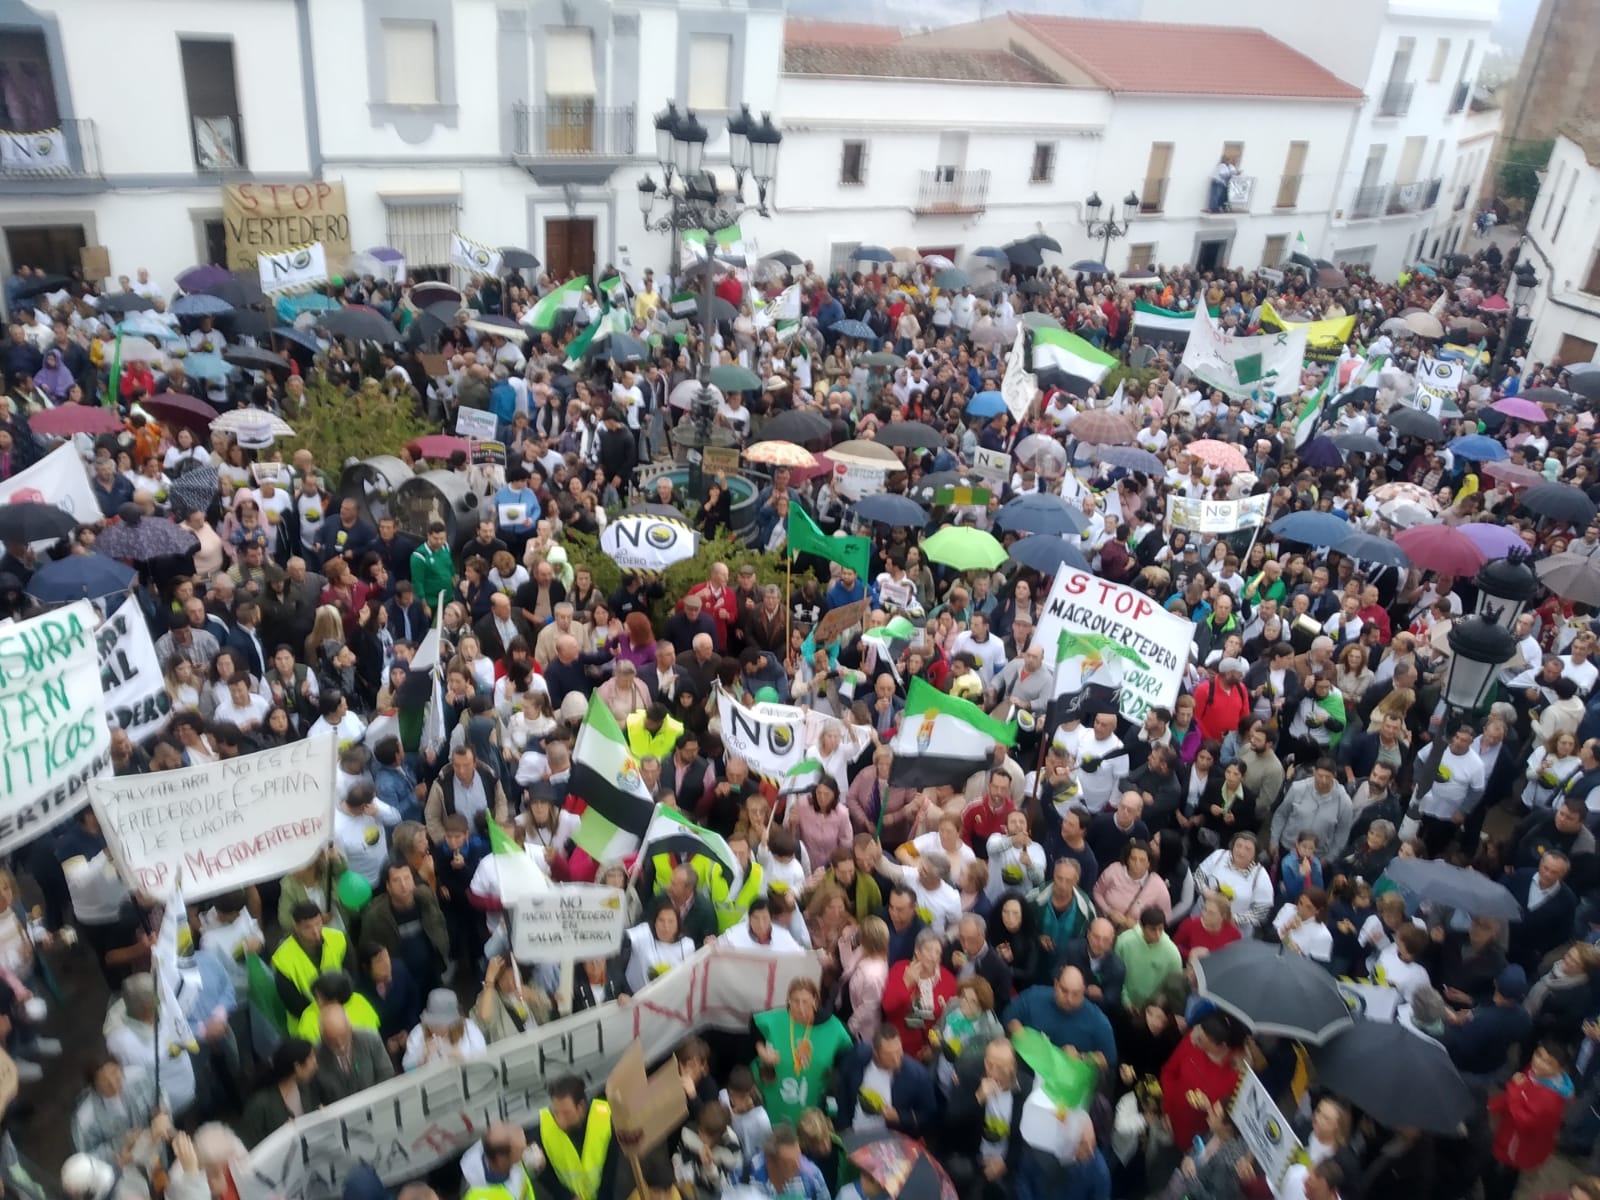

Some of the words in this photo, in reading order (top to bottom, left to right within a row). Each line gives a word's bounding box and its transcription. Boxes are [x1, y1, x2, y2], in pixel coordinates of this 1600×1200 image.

[238, 183, 332, 211] STOP
[226, 214, 349, 246] VERTEDERO
[270, 250, 312, 279] NO
[1421, 358, 1453, 379] NO
[615, 520, 678, 550] NO
[1065, 574, 1153, 620] STOP
[1048, 597, 1178, 671] MACROVERTEDERO
[731, 705, 795, 756] NO
[222, 760, 250, 778] NO
[256, 754, 281, 771] ES
[559, 896, 583, 909] NO
[562, 921, 578, 929] EN
